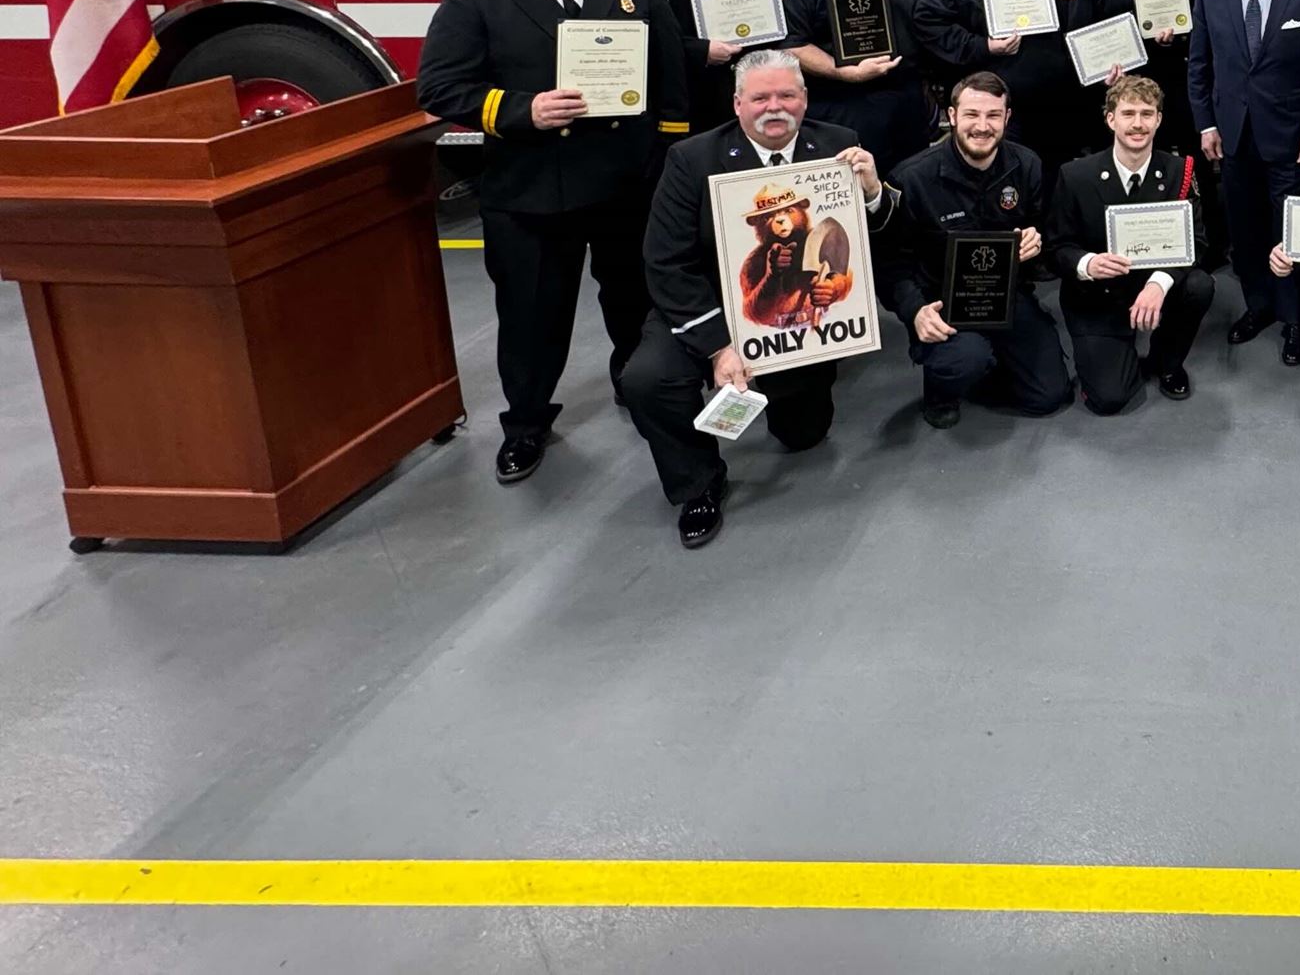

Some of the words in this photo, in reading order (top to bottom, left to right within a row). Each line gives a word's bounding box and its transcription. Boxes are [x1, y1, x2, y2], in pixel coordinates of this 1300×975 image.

[794, 174, 802, 185] 2
[804, 170, 843, 184] ALARM
[813, 181, 840, 194] SHED
[816, 199, 852, 214] AWARD
[743, 327, 807, 360] ONLY
[814, 316, 867, 346] YOU
